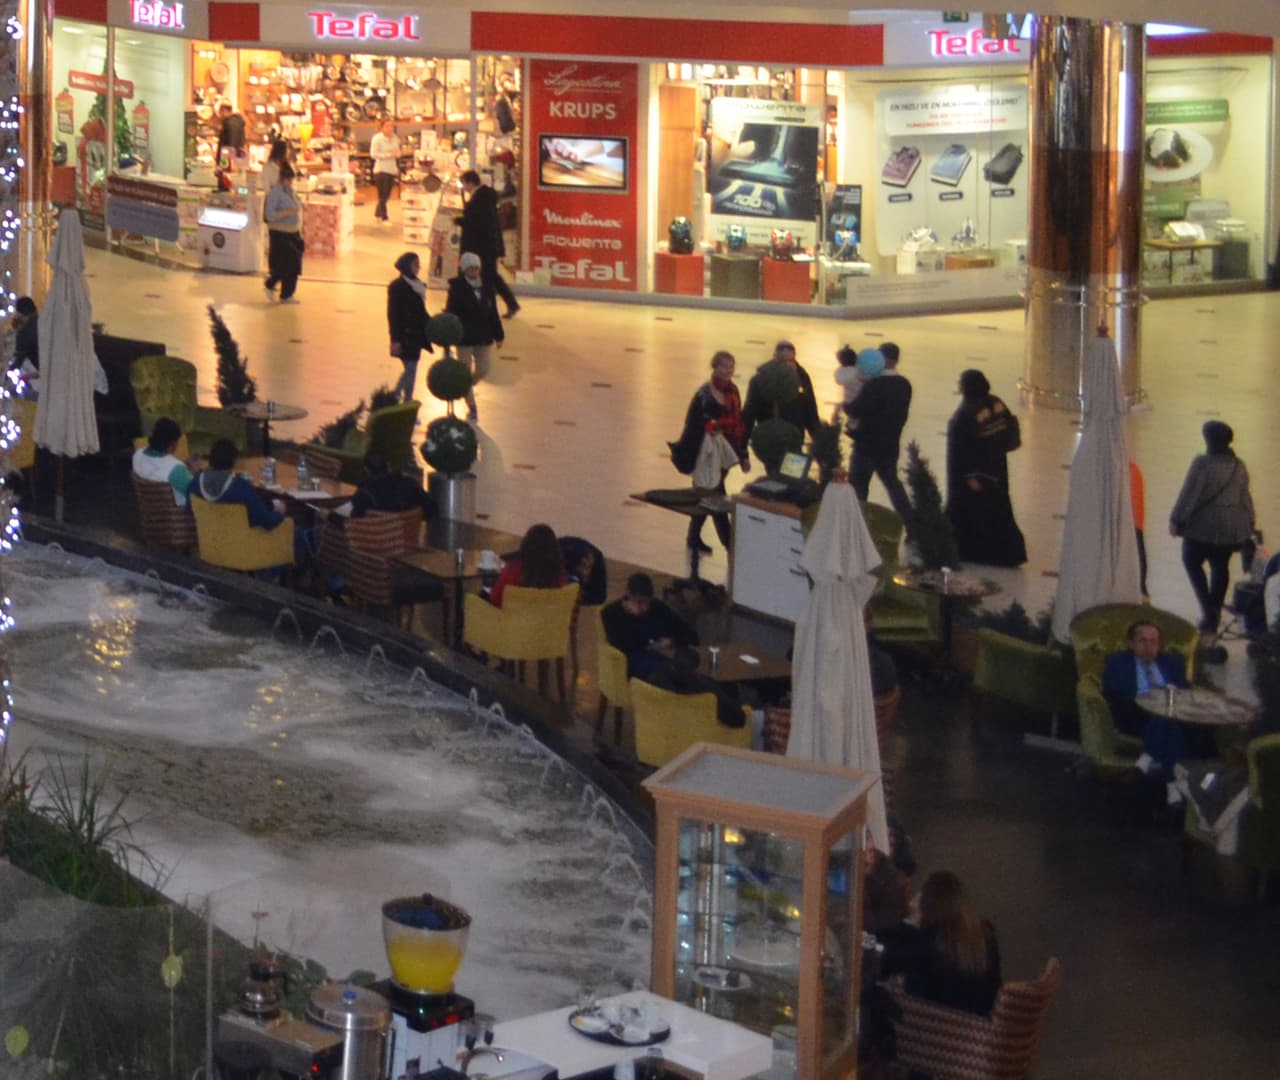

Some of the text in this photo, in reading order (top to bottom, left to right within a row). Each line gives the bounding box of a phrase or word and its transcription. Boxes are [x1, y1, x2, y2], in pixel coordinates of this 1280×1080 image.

[307, 10, 420, 41] Tefal
[549, 100, 617, 120] KRUPS
[543, 208, 623, 228] Moulinex
[534, 255, 632, 283] Tefal
